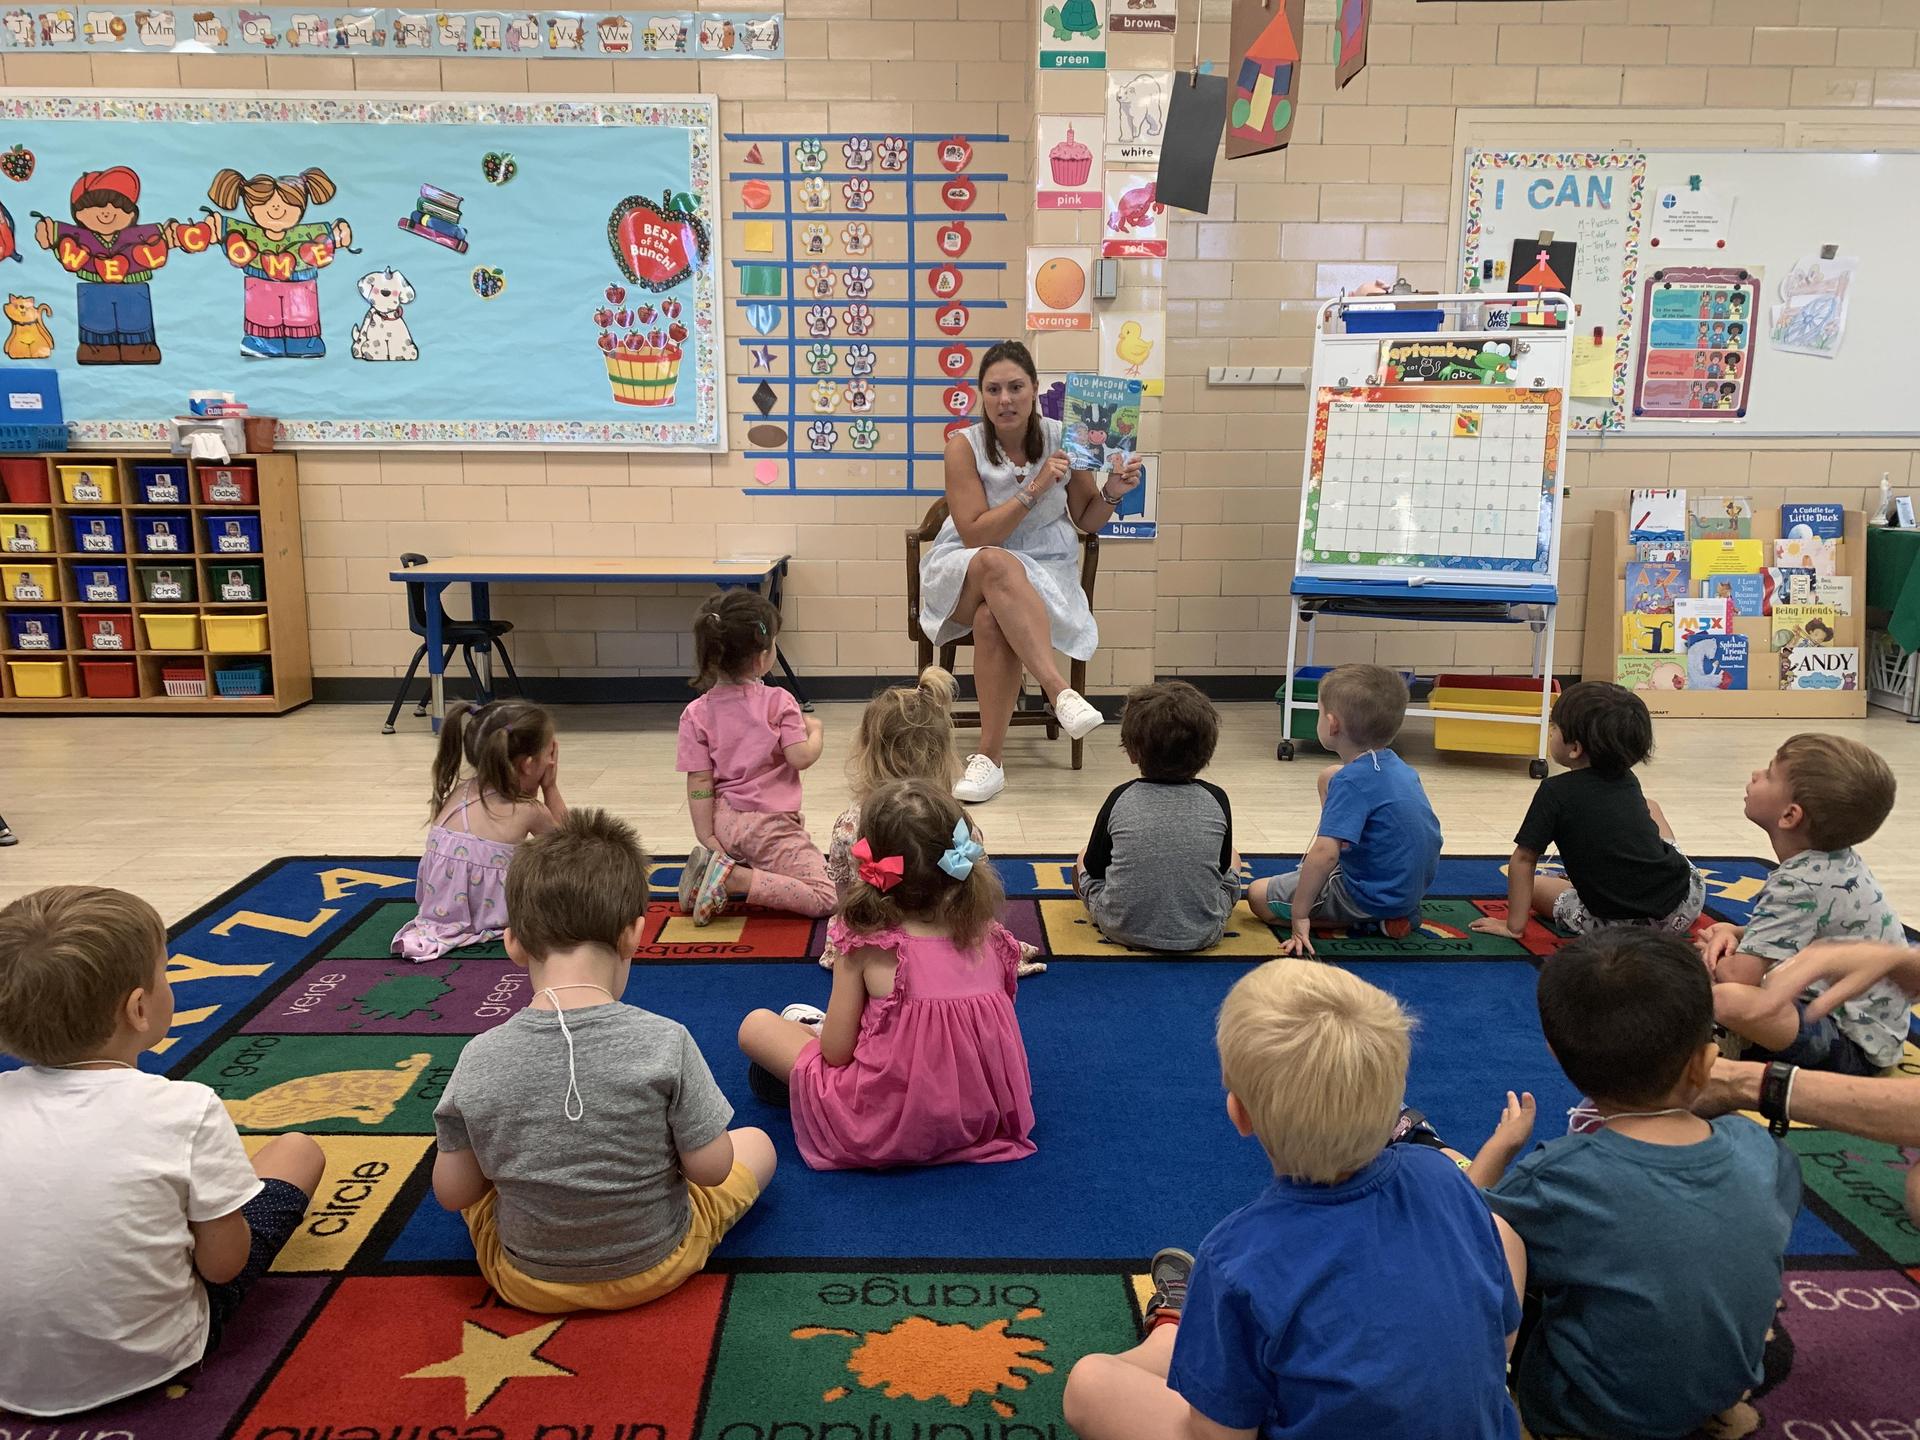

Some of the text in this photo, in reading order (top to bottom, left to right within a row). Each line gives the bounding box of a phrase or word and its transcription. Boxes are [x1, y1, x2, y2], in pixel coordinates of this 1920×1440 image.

[1123, 17, 1161, 28] brown
[148, 21, 174, 36] Mm
[197, 22, 216, 36] Nn
[297, 22, 314, 43] Pp
[406, 23, 423, 38] Rr
[444, 25, 460, 39] Ss
[481, 25, 496, 39] Tt
[520, 26, 538, 40] Uu
[556, 26, 573, 40] Vv
[602, 26, 629, 41] Ww
[658, 26, 676, 41] Xx
[708, 27, 723, 46] Yy
[1055, 54, 1089, 68] green
[1121, 146, 1154, 158] white
[1495, 174, 1613, 210] I CAN
[1057, 194, 1082, 207] pink
[644, 223, 678, 244] BEST
[641, 237, 669, 254] of the
[1124, 243, 1144, 254] red
[62, 227, 334, 282] WELCOME
[630, 244, 677, 271] Bunch!
[1488, 310, 1509, 321] Wet
[1038, 316, 1079, 329] orange
[1487, 318, 1509, 329] Ones
[1390, 341, 1478, 363] eptember
[1451, 370, 1473, 380] abc
[150, 489, 175, 499] Teddy
[214, 488, 237, 498] Gabe
[1788, 513, 1839, 523] Little Duck
[1112, 524, 1137, 535] blue
[15, 542, 33, 551] Sam
[88, 539, 106, 548] Nick
[222, 540, 247, 549] Quinn
[18, 587, 246, 598] Finn Pete Chris Ezra
[1775, 606, 1799, 616] Being
[1801, 606, 1833, 615] Friends
[96, 637, 118, 646] Clara
[1719, 641, 1746, 650] Splendid
[1721, 653, 1743, 661] Indeed
[1725, 648, 1747, 656] Friend,
[1798, 653, 1854, 672] ANDY
[635, 943, 755, 956] square
[1329, 940, 1474, 953] rainbow
[282, 972, 347, 1016] verde
[474, 972, 529, 1018] green
[219, 1036, 281, 1078] gato
[416, 1066, 456, 1100] cat
[307, 1160, 390, 1238] circle
[817, 1276, 1041, 1308] orange
[1788, 1279, 1920, 1315] dog
